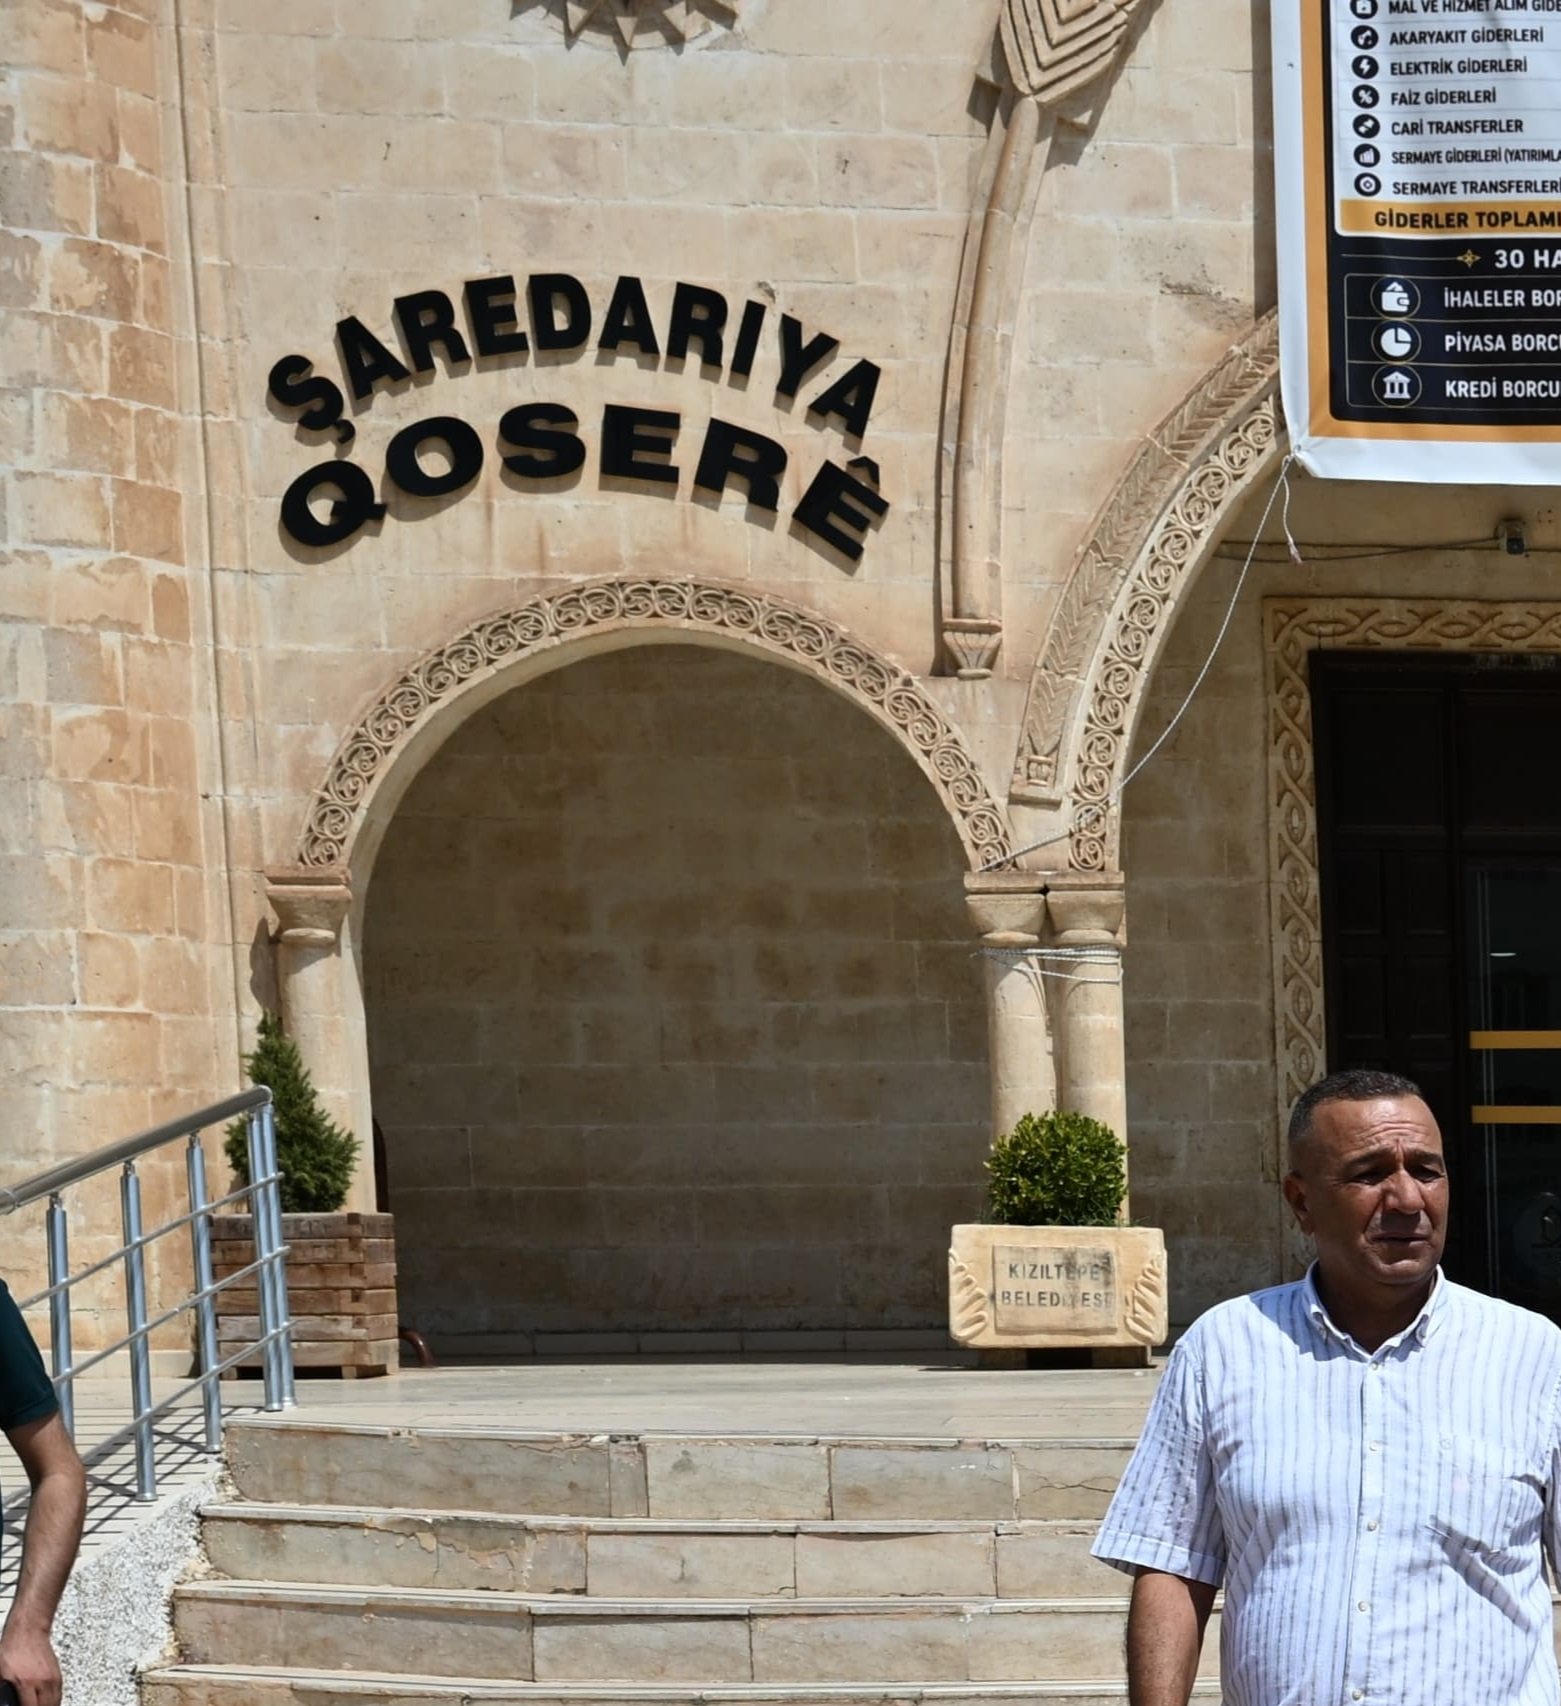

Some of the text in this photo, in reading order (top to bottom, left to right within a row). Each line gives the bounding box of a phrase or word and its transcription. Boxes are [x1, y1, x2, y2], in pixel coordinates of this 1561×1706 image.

[1389, 0, 1417, 14] MAL
[1422, 0, 1438, 13] VE
[1494, 0, 1528, 11] ALIM
[1390, 30, 1466, 46] AKARYAKIT
[1472, 26, 1544, 42] GİDERLERİ
[1391, 60, 1453, 76] ELEKTRİK
[1458, 56, 1528, 74] GİDERLERİ
[1391, 90, 1420, 105] FAİZ
[1424, 86, 1496, 104] GİDERLERİ
[1392, 119, 1424, 135] CARİ
[1428, 120, 1523, 134] TRANSFERLER
[1392, 150, 1442, 164] SERMAYE
[1446, 148, 1501, 163] GİDERLERİ
[1392, 182, 1457, 195] SERMAYE
[1375, 208, 1468, 228] GİDERLER
[1476, 212, 1561, 227] TOPLAMI
[1495, 249, 1525, 269] 30
[1444, 287, 1526, 308] İHALELER
[1445, 330, 1506, 352] PİYASA
[1445, 377, 1497, 398] KREDİ
[280, 402, 889, 561] QOSERÊ
